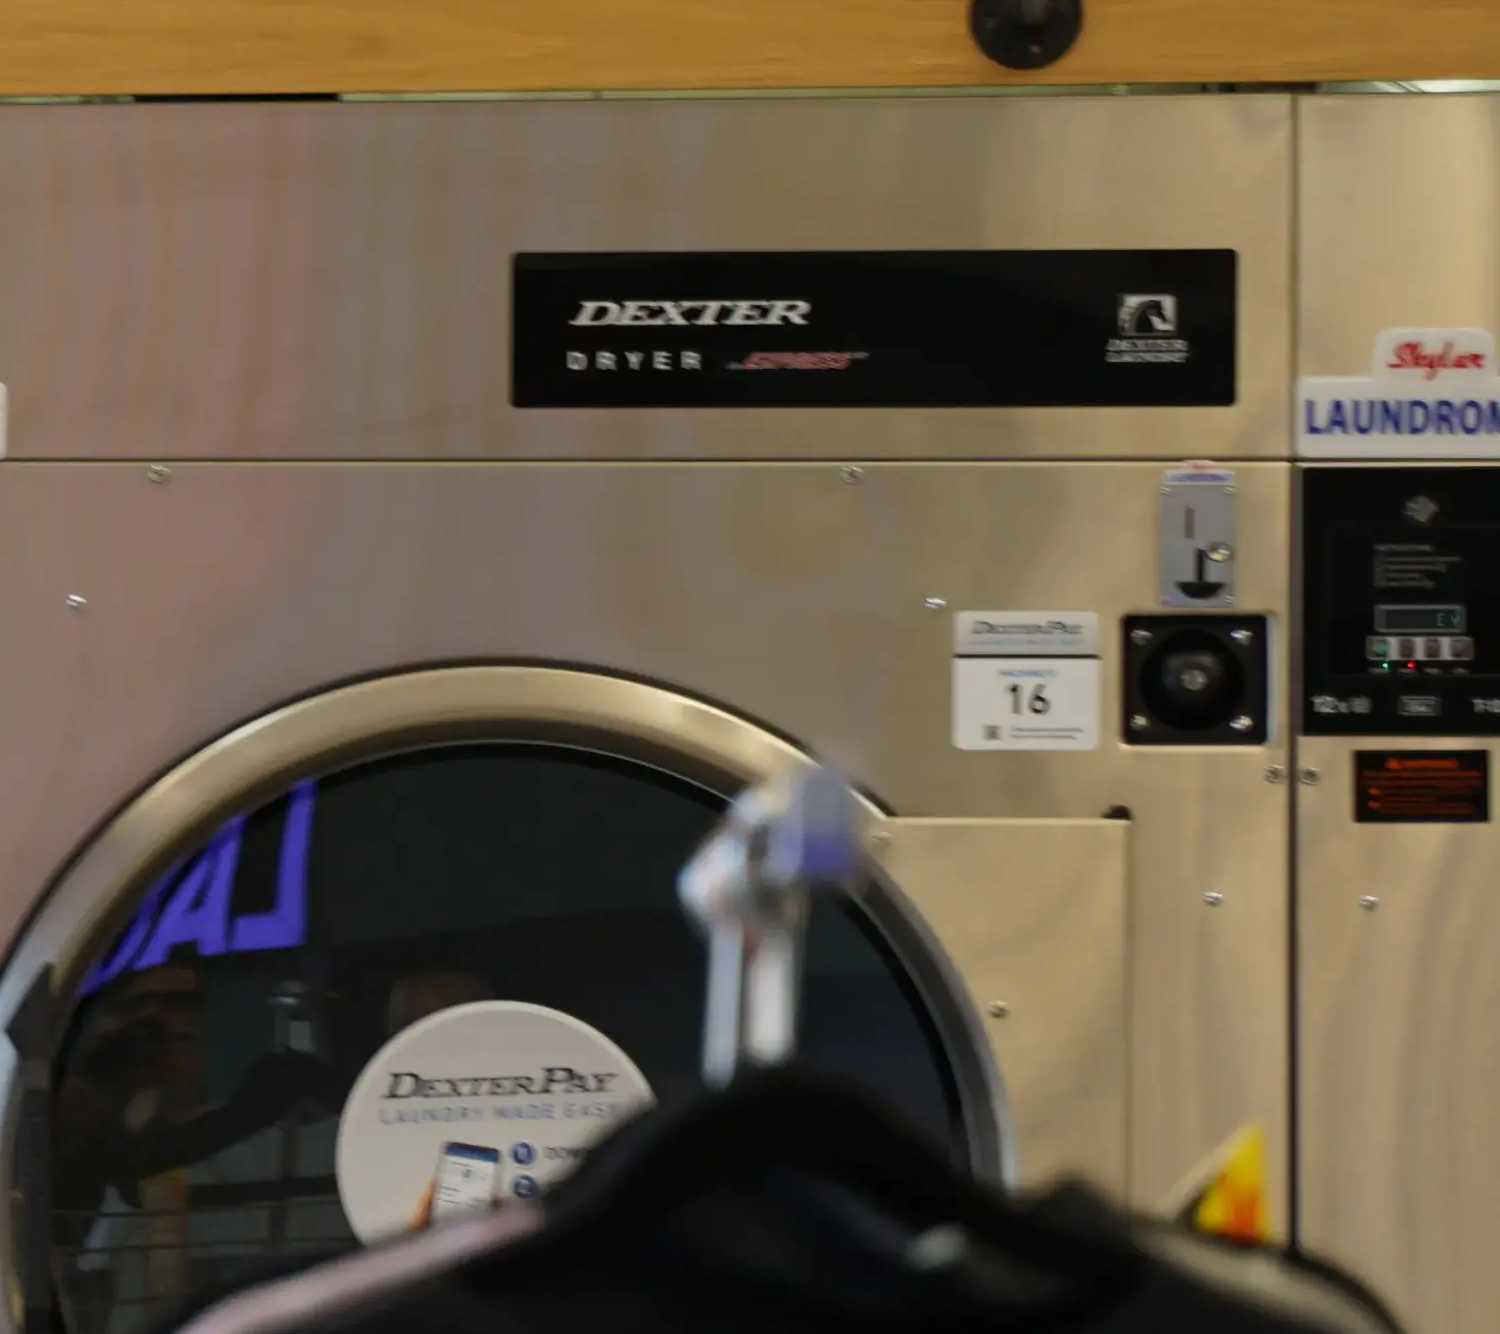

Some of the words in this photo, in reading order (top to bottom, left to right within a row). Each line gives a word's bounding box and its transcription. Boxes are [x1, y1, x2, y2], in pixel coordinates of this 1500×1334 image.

[568, 299, 811, 326] DEXTER
[565, 350, 702, 371] DRYER
[1005, 682, 1052, 716] 16
